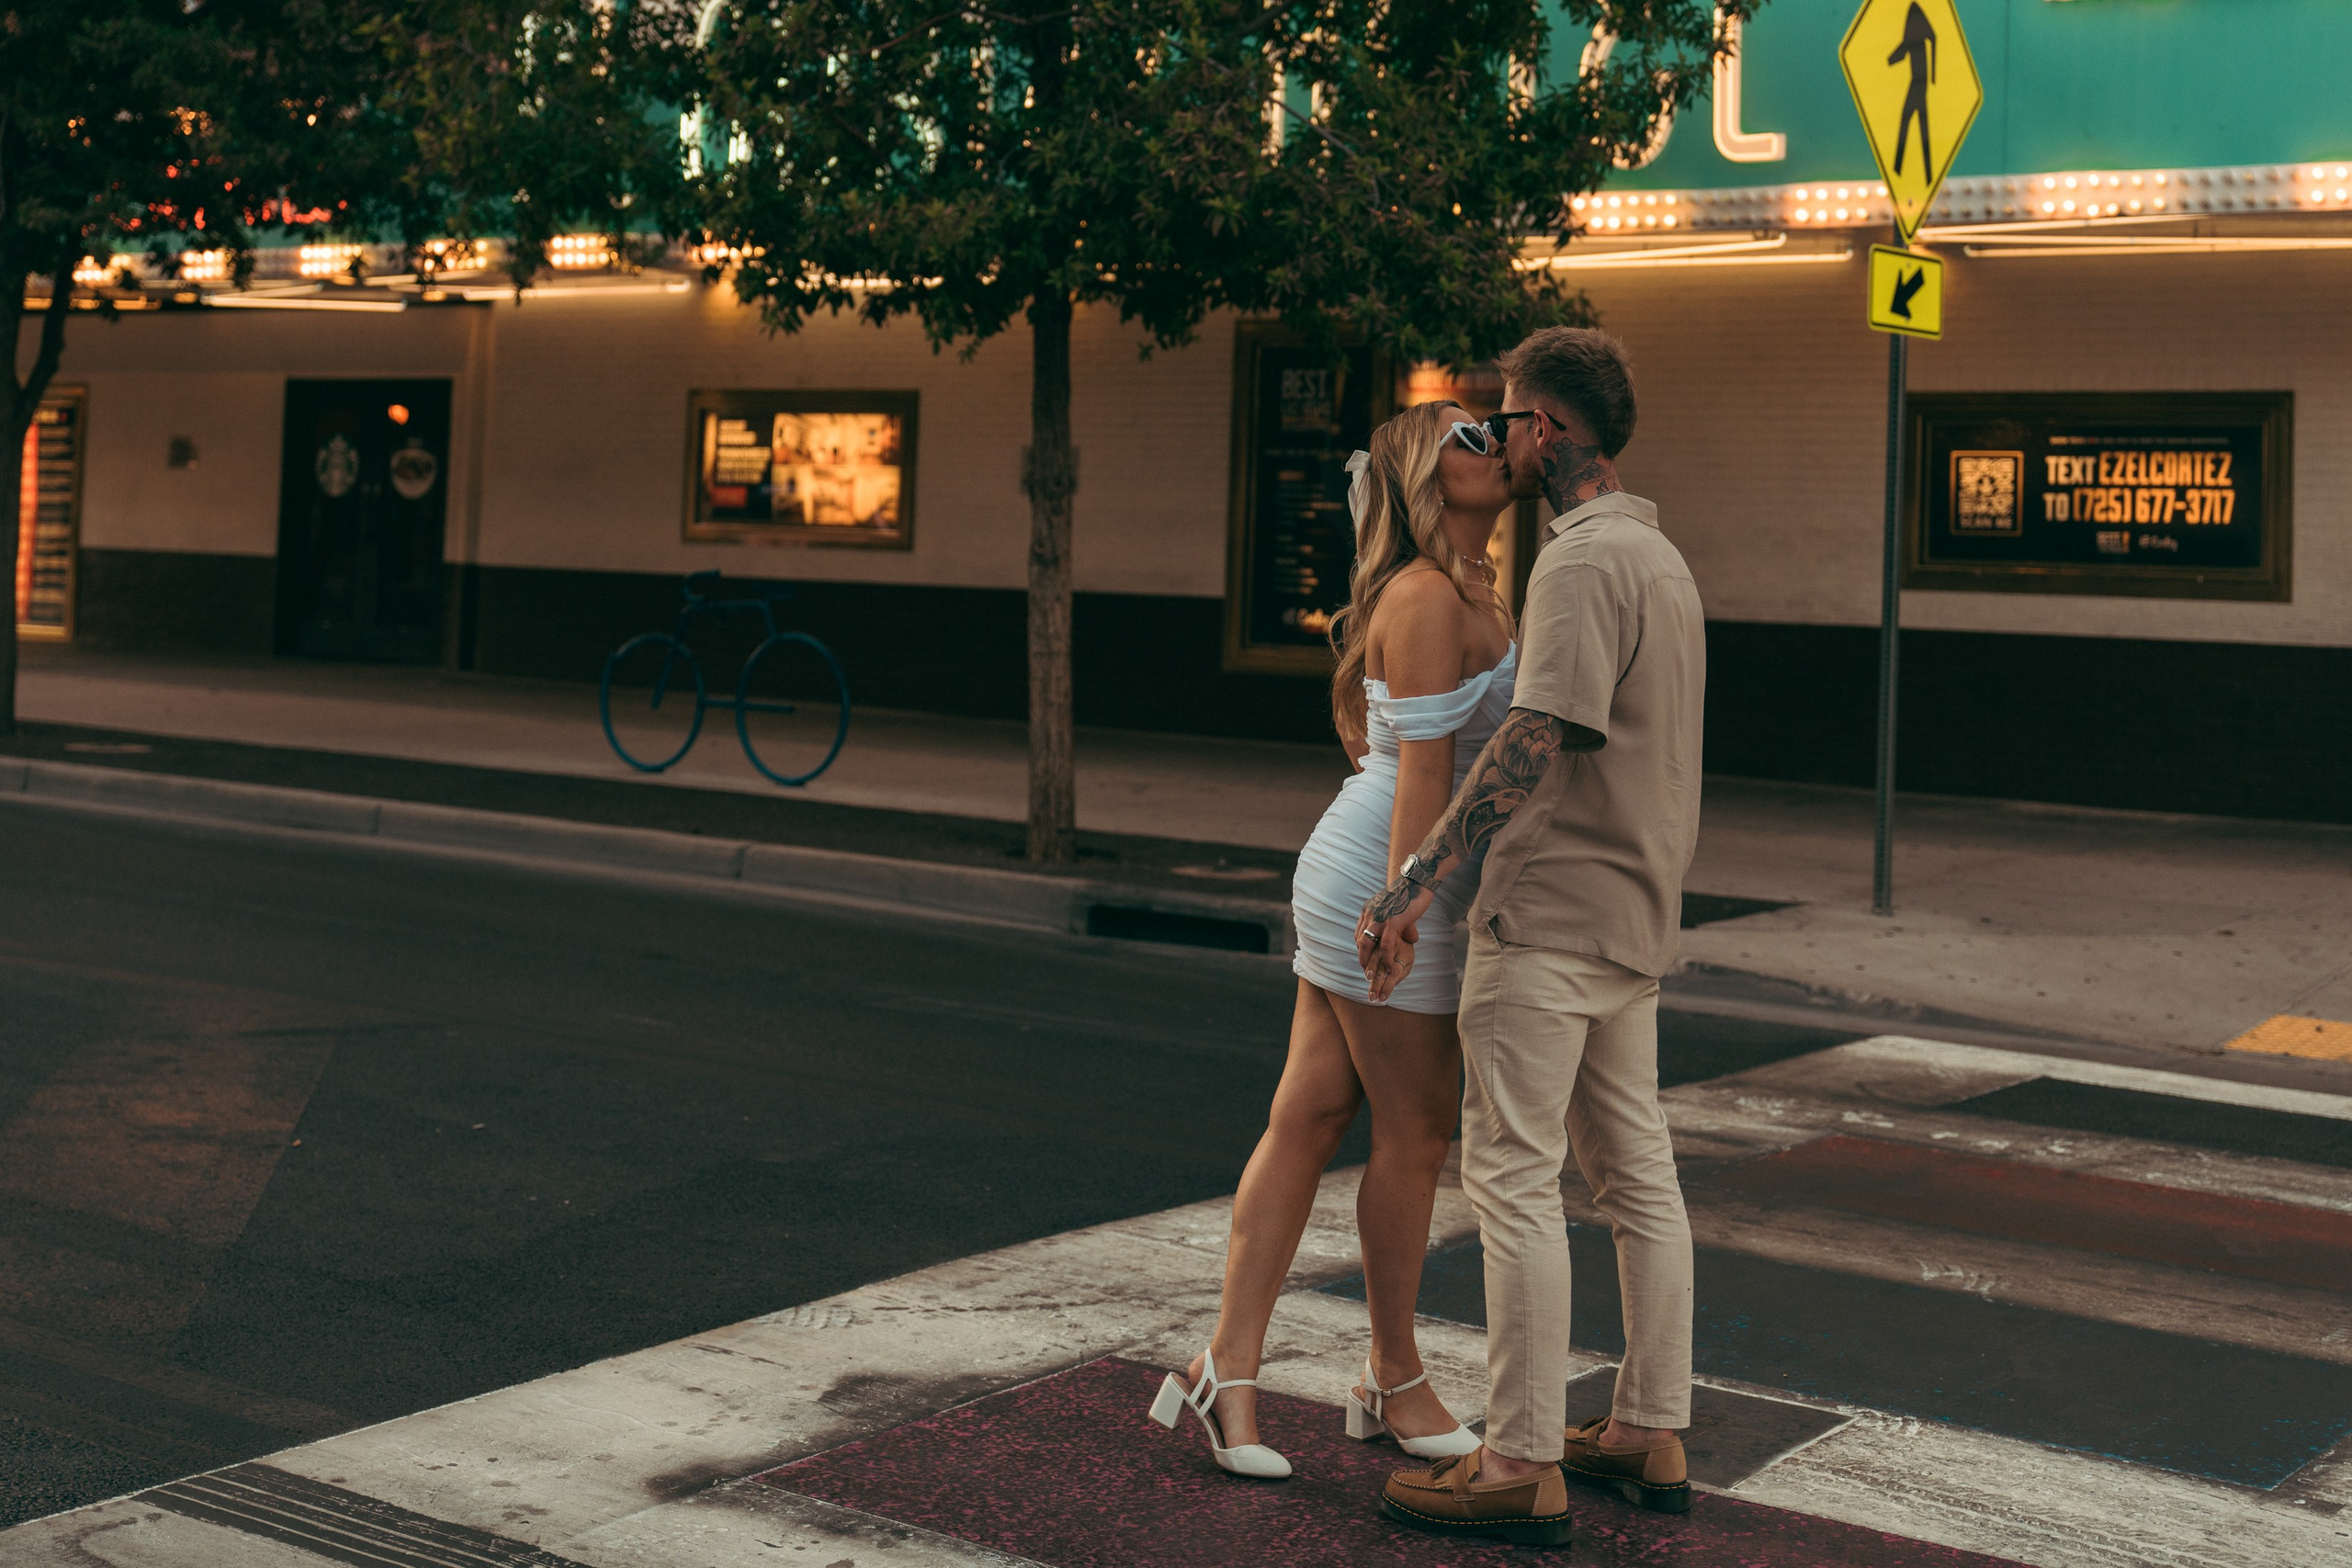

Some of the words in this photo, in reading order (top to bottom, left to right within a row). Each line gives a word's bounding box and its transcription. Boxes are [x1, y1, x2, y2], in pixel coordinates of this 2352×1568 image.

[2044, 456, 2096, 486] TEXT
[2042, 492, 2069, 523] TO
[2073, 487, 2132, 523] (725)
[2134, 488, 2235, 525] 677-3717
